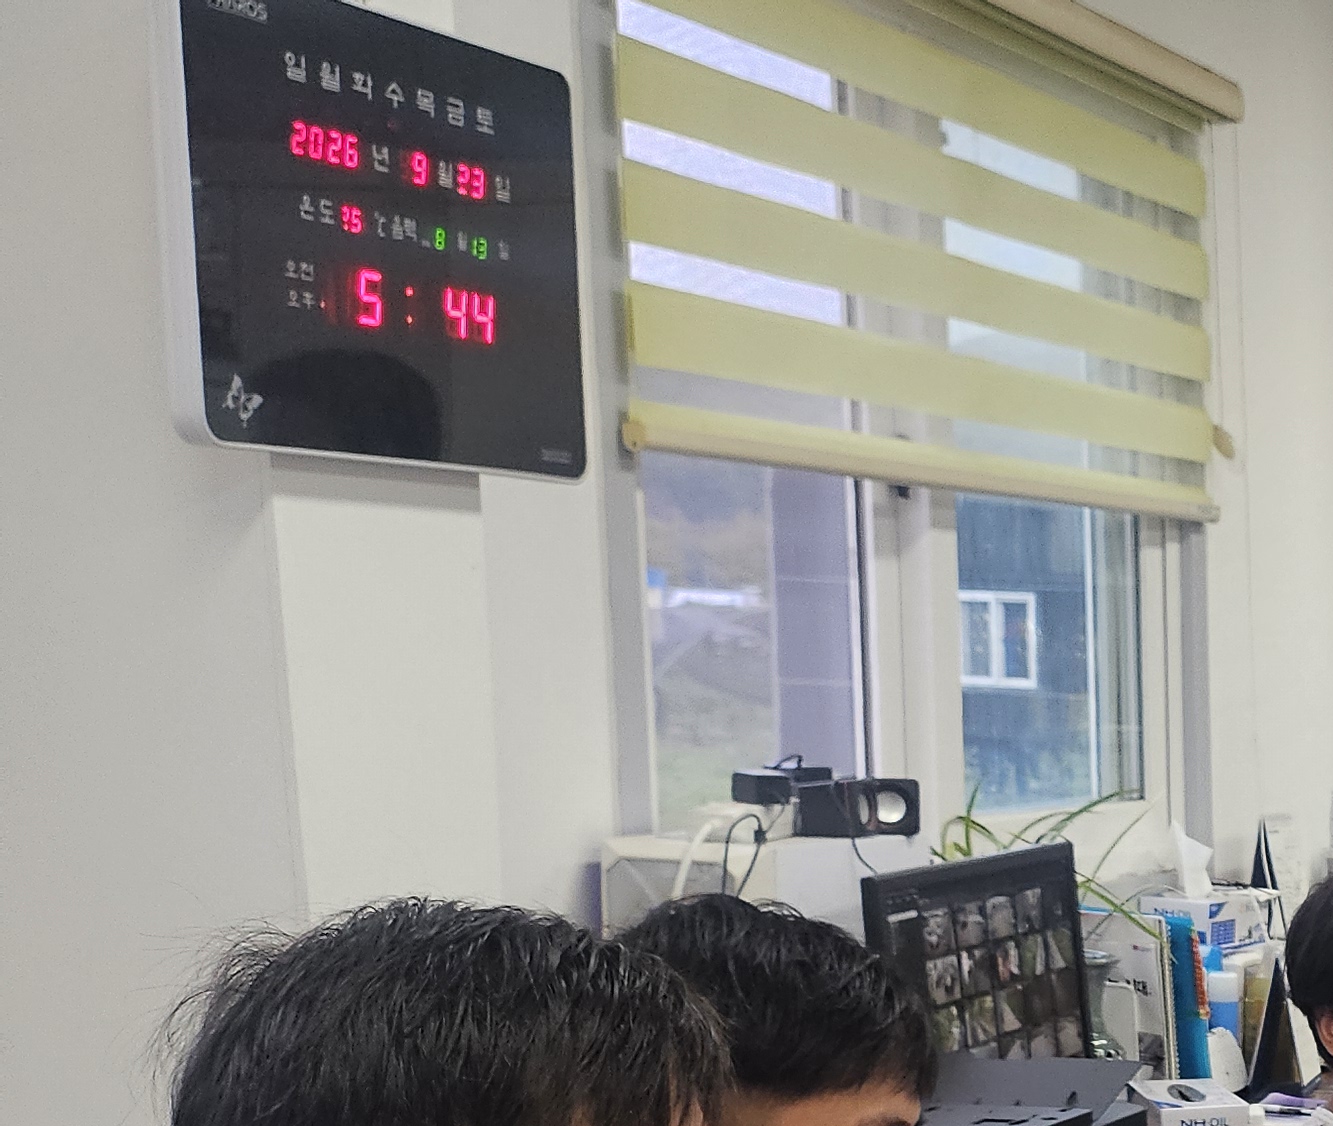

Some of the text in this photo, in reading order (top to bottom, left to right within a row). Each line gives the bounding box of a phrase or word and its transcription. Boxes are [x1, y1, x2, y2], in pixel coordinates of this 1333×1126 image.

[284, 51, 495, 136] 일 월 화 수 목 금 토
[289, 119, 360, 170] 2026
[372, 144, 390, 174] 년
[410, 151, 430, 187] 9
[438, 160, 453, 189] 월
[495, 175, 511, 204] 일
[299, 194, 335, 225] 온도
[284, 259, 315, 282] 오전
